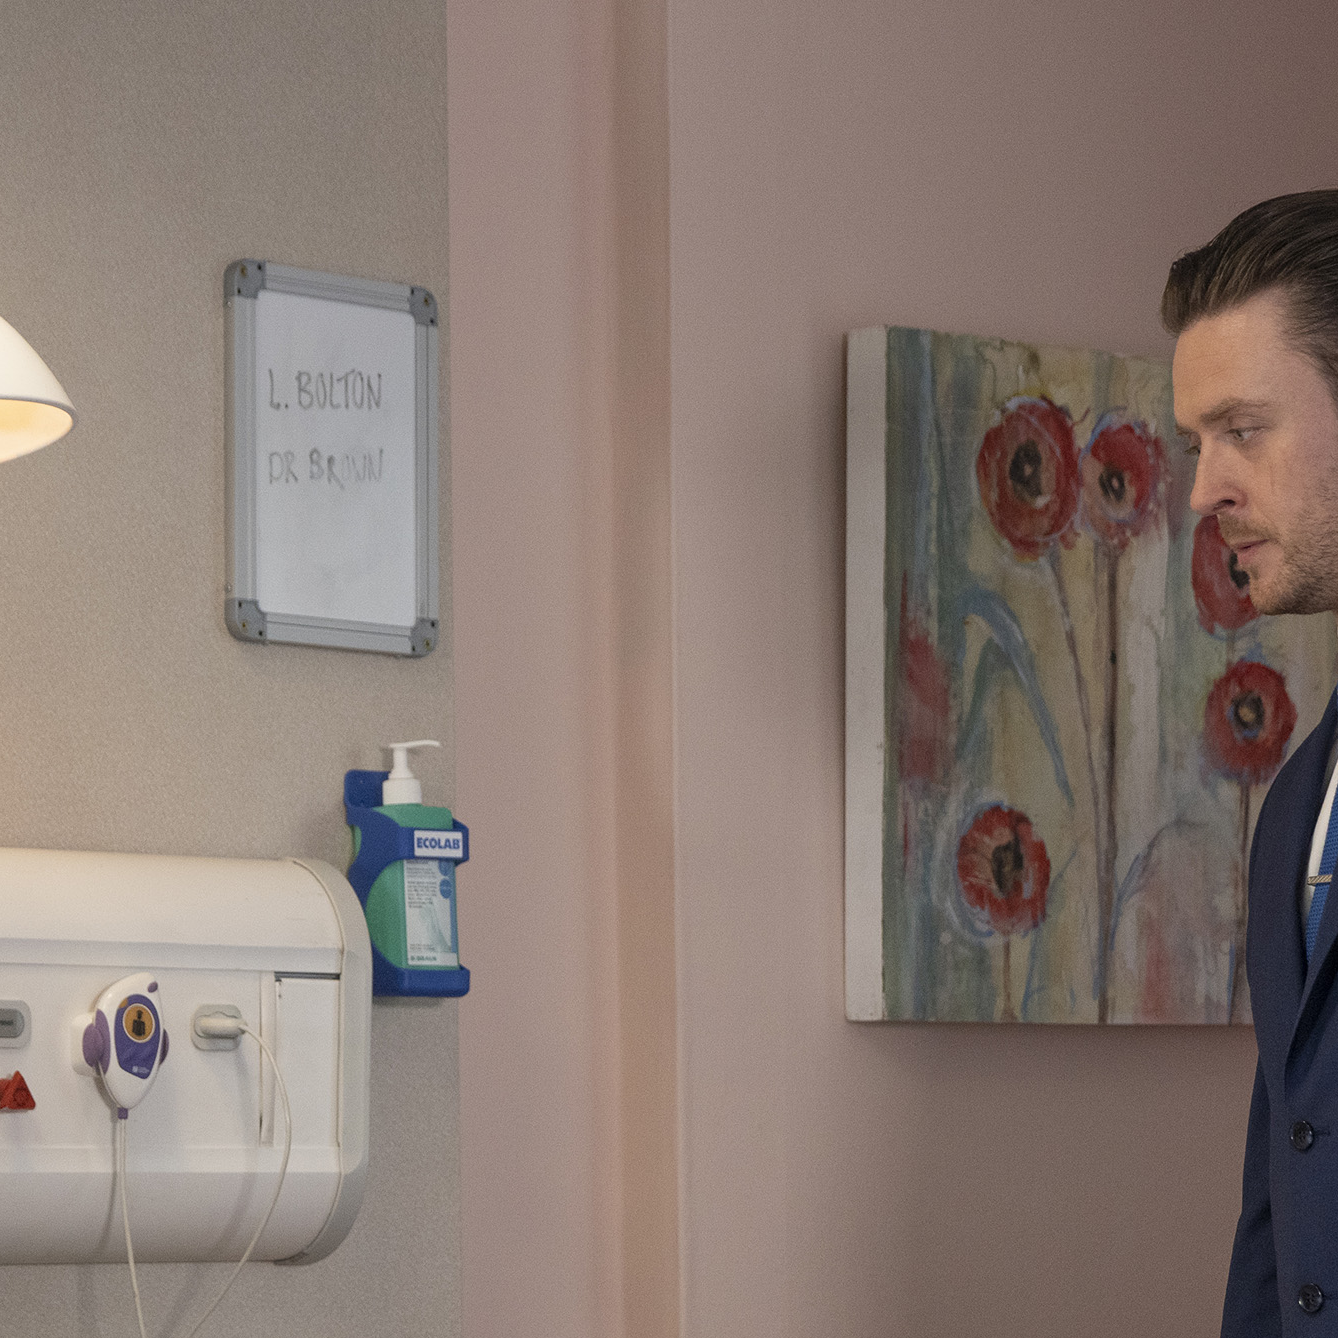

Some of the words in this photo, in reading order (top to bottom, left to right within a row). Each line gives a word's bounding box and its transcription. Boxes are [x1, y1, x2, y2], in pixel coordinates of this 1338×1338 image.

[268, 370, 290, 411] L.
[295, 368, 383, 411] BOLTON
[269, 450, 299, 485] DR
[416, 836, 461, 851] ECOLAB
